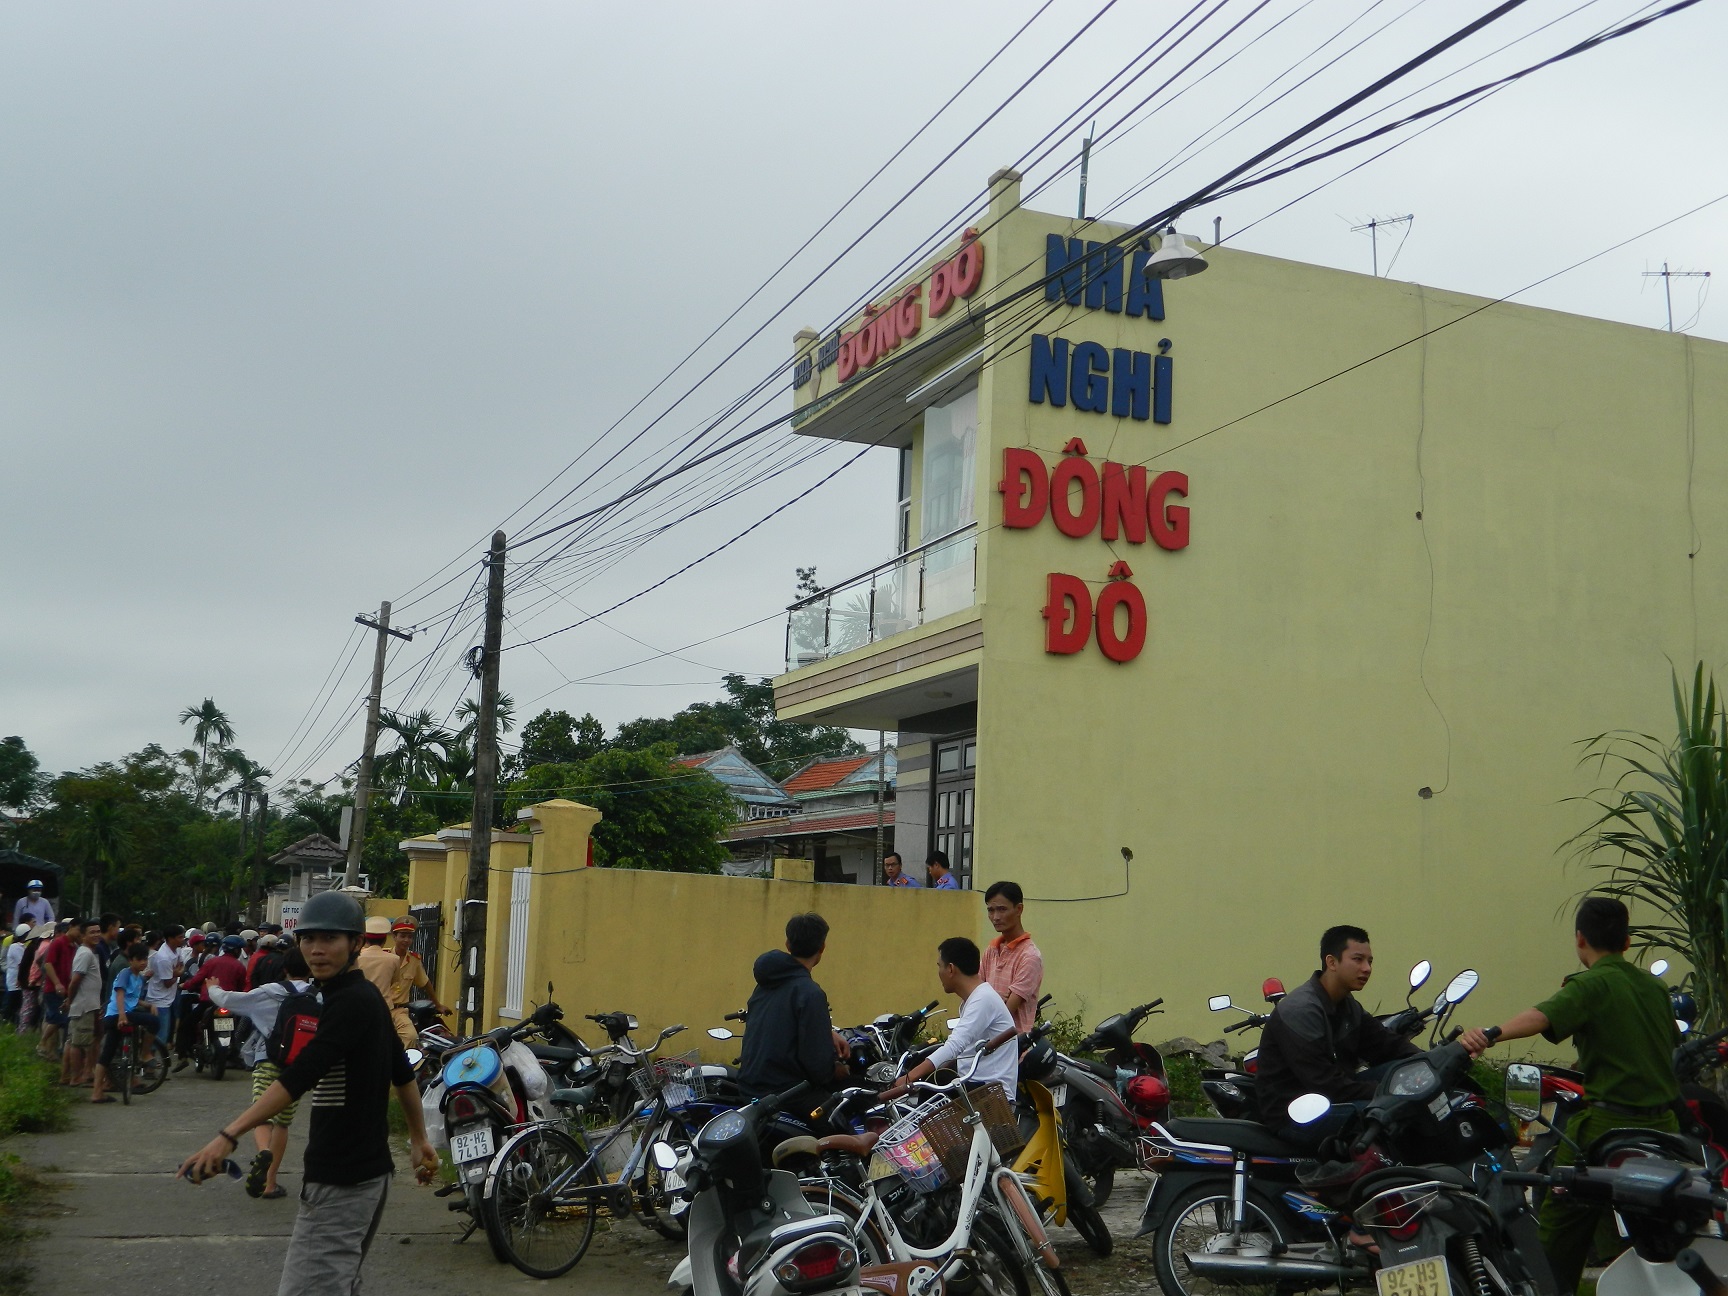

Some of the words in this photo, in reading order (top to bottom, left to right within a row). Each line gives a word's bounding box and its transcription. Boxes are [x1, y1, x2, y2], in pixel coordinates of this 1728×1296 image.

[837, 282, 923, 384] ĐÔNG
[928, 226, 985, 319] ĐÔ
[1045, 232, 1166, 321] NHÀ
[1029, 337, 1174, 425] NGHỈ
[998, 436, 1191, 551] ĐÔNG
[1042, 560, 1148, 663] ĐÔ
[456, 1131, 487, 1149] 92-H2
[458, 1143, 488, 1161] 7413
[1387, 1261, 1438, 1291] 92-H3
[1397, 1243, 1419, 1254] HONDA
